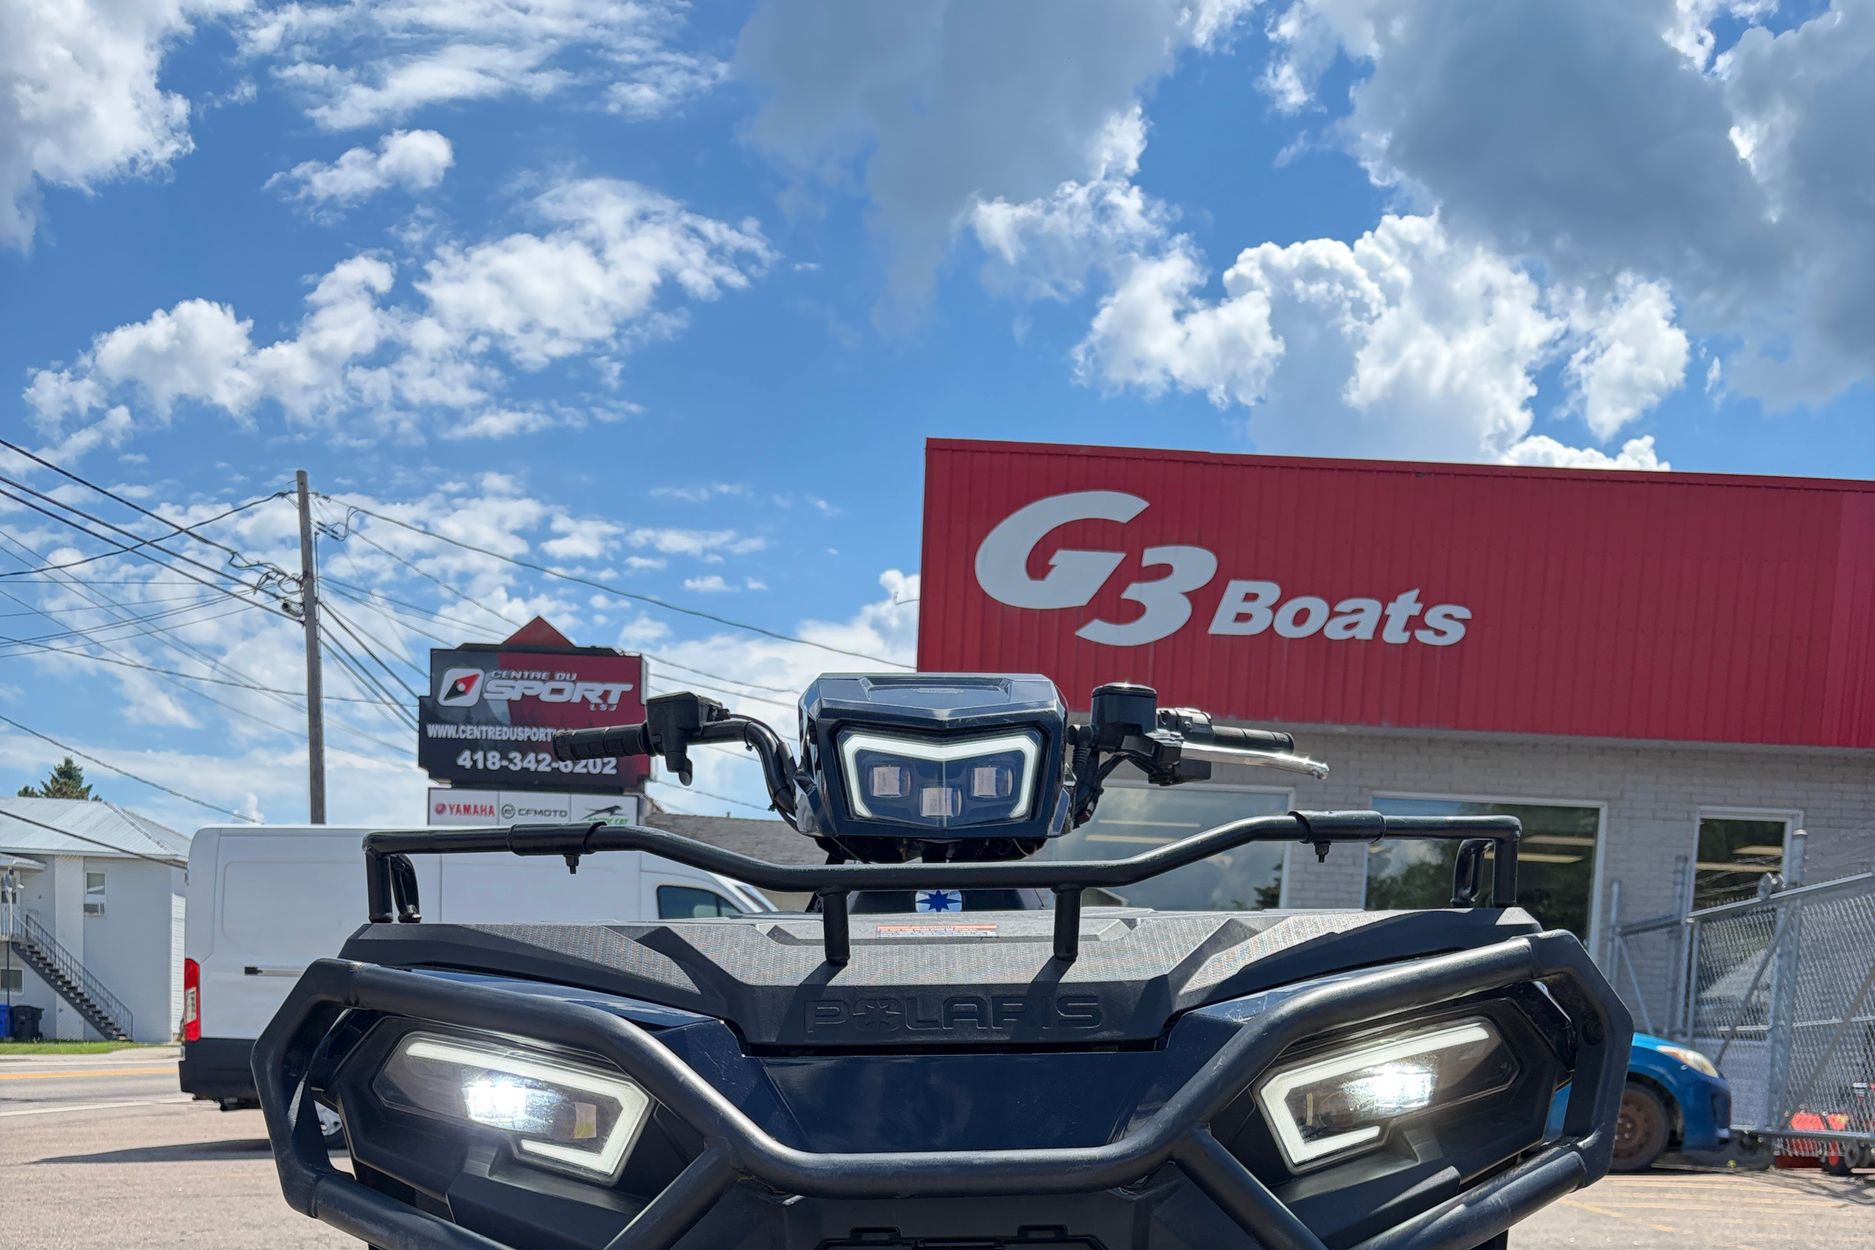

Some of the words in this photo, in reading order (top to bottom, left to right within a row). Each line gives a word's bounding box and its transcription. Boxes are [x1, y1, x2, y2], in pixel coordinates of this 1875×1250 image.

[975, 490, 1218, 646] G3
[1208, 579, 1473, 646] Boats
[491, 670, 551, 681] CENTRE
[554, 671, 578, 681] DU
[483, 679, 634, 704] SPORT
[426, 723, 557, 742] WWW.CENTREDUSPORT
[449, 803, 496, 817] YAMAHA
[517, 806, 568, 819] CFMOTO
